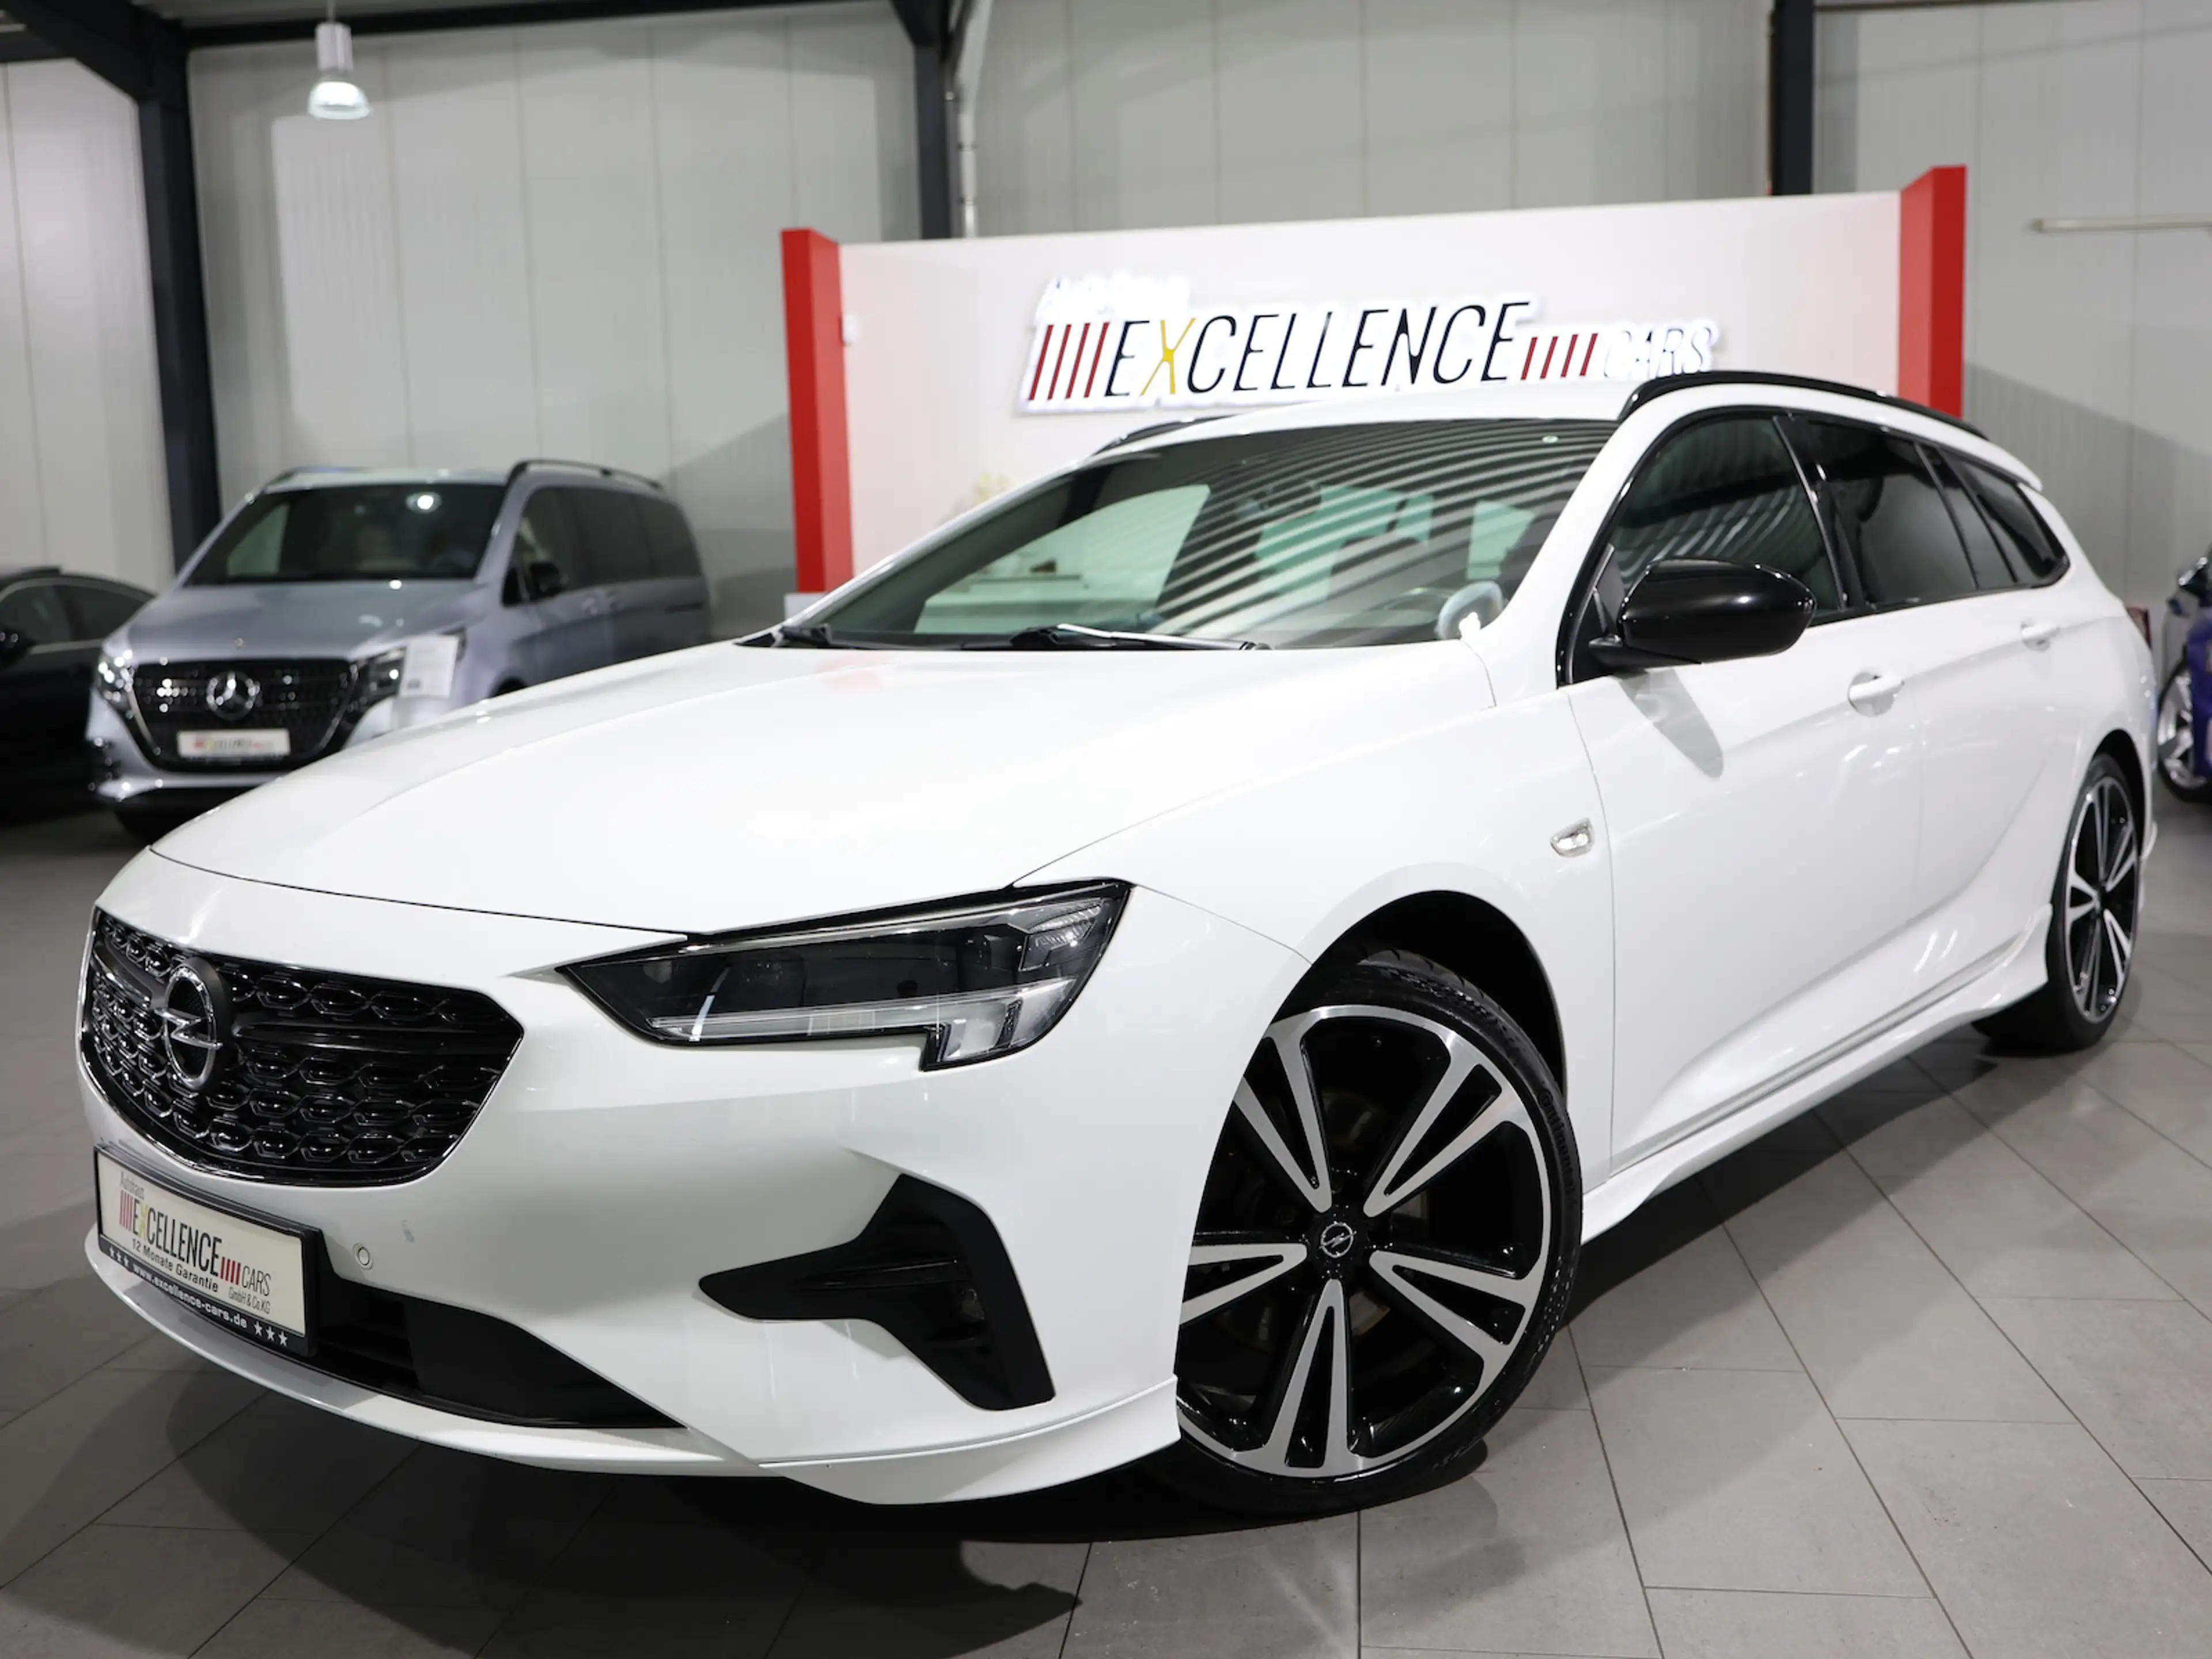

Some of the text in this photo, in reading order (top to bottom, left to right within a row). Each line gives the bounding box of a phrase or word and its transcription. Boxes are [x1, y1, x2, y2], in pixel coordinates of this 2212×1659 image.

[1104, 302, 1529, 396] EXCELLENCE
[132, 1198, 271, 1296] EXCELLENCE CARS
[132, 1238, 218, 1292] 12 Monate Garantie
[133, 1263, 247, 1328] www.excellence-cars.de
